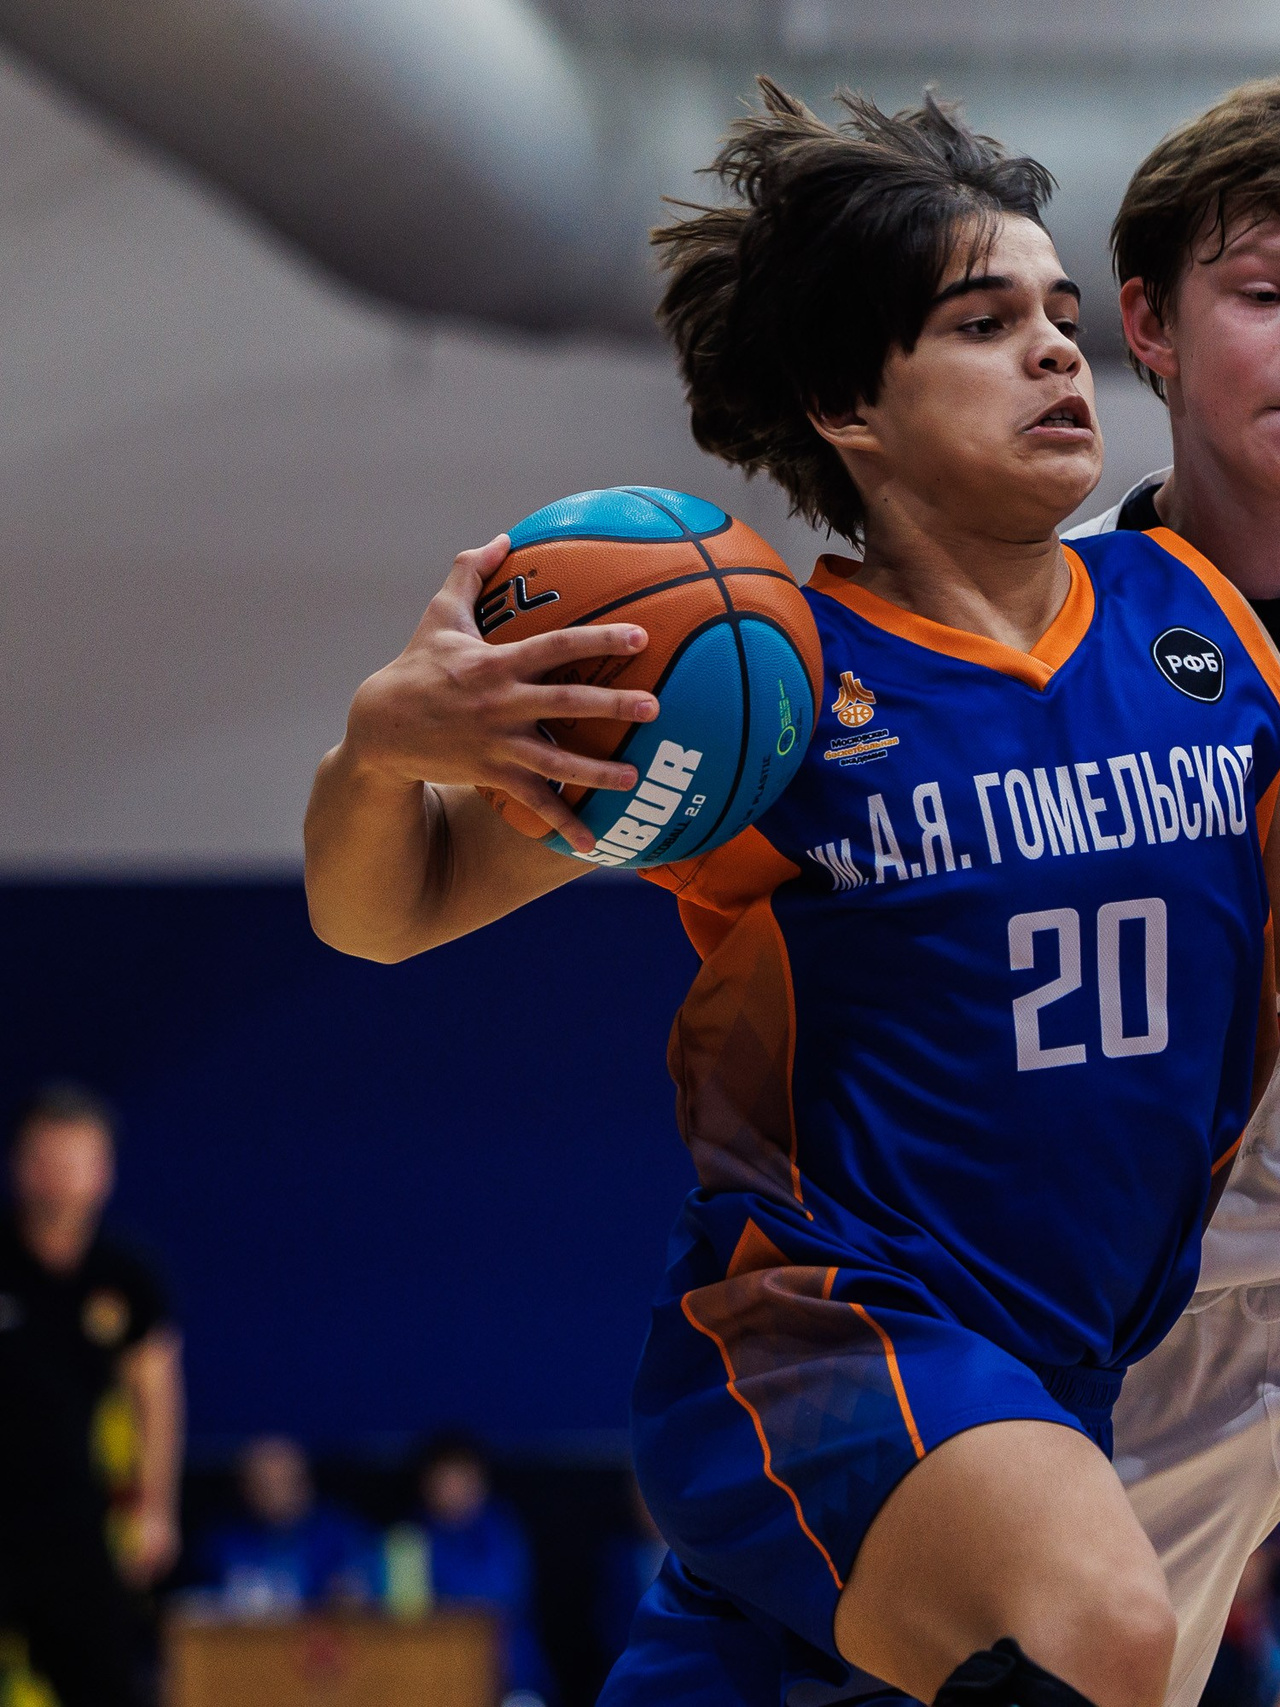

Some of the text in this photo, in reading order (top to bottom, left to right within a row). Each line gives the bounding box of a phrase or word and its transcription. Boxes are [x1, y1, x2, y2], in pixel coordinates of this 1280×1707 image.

[475, 575, 561, 636] EL
[1165, 652, 1219, 674] РФБ
[571, 739, 703, 866] SIBUR
[684, 794, 707, 817] 2.0
[1007, 897, 1169, 1072] 20
